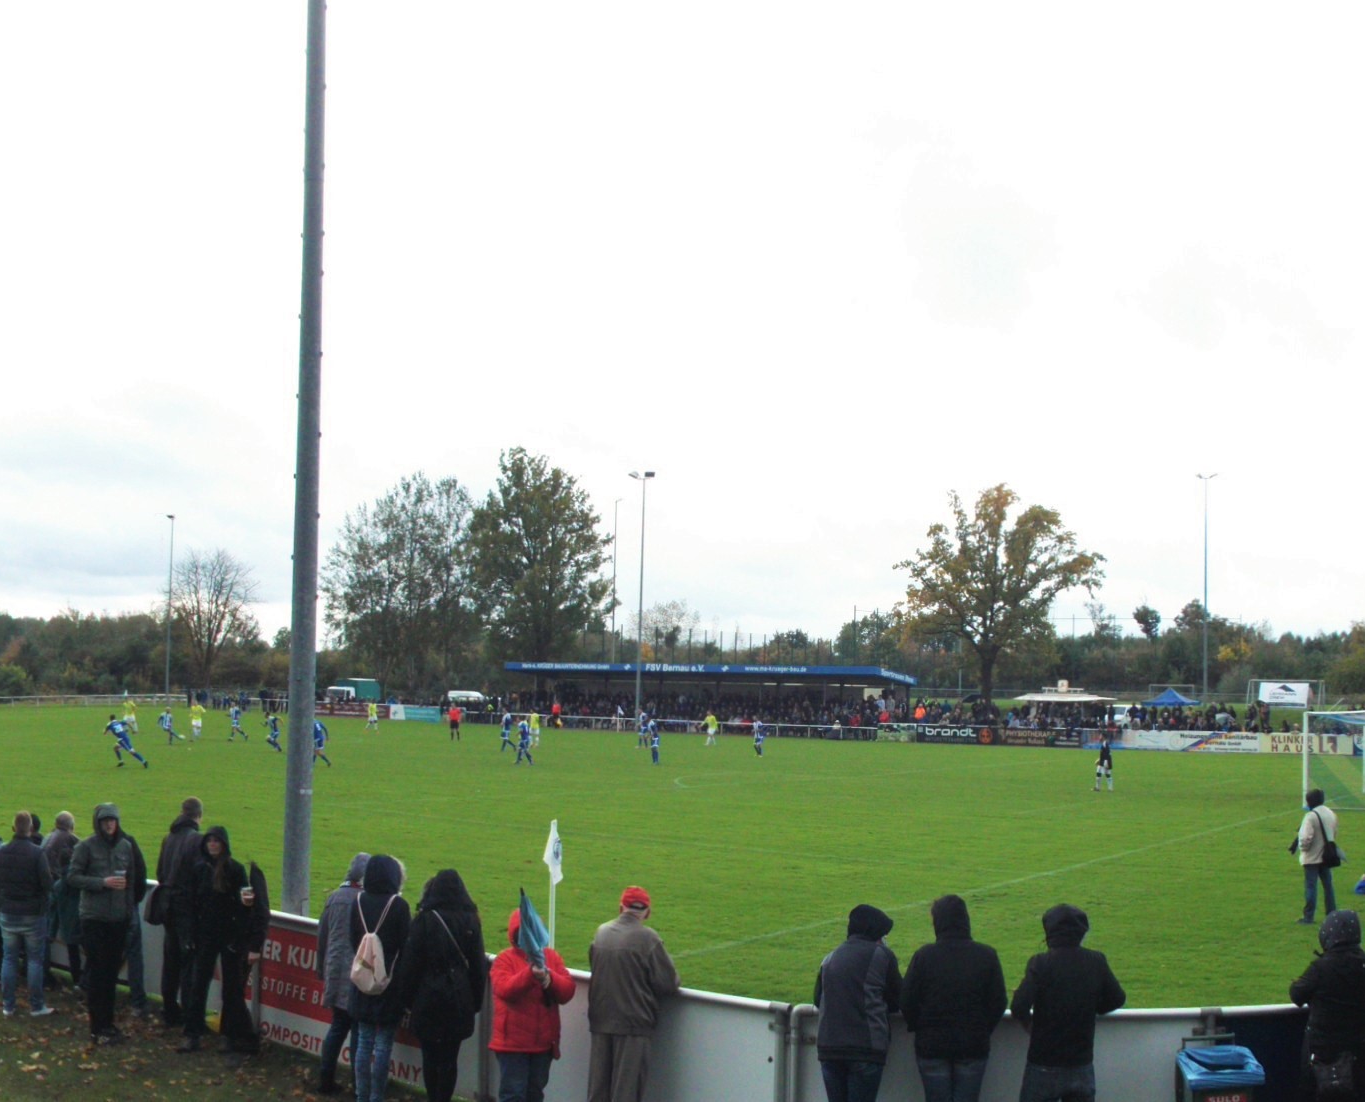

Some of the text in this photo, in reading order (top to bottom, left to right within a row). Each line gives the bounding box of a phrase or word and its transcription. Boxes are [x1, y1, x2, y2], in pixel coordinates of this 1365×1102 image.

[645, 663, 661, 671] FSV
[925, 727, 977, 737] brandt
[262, 939, 282, 962] ER
[260, 1022, 322, 1052] OMPOSIT
